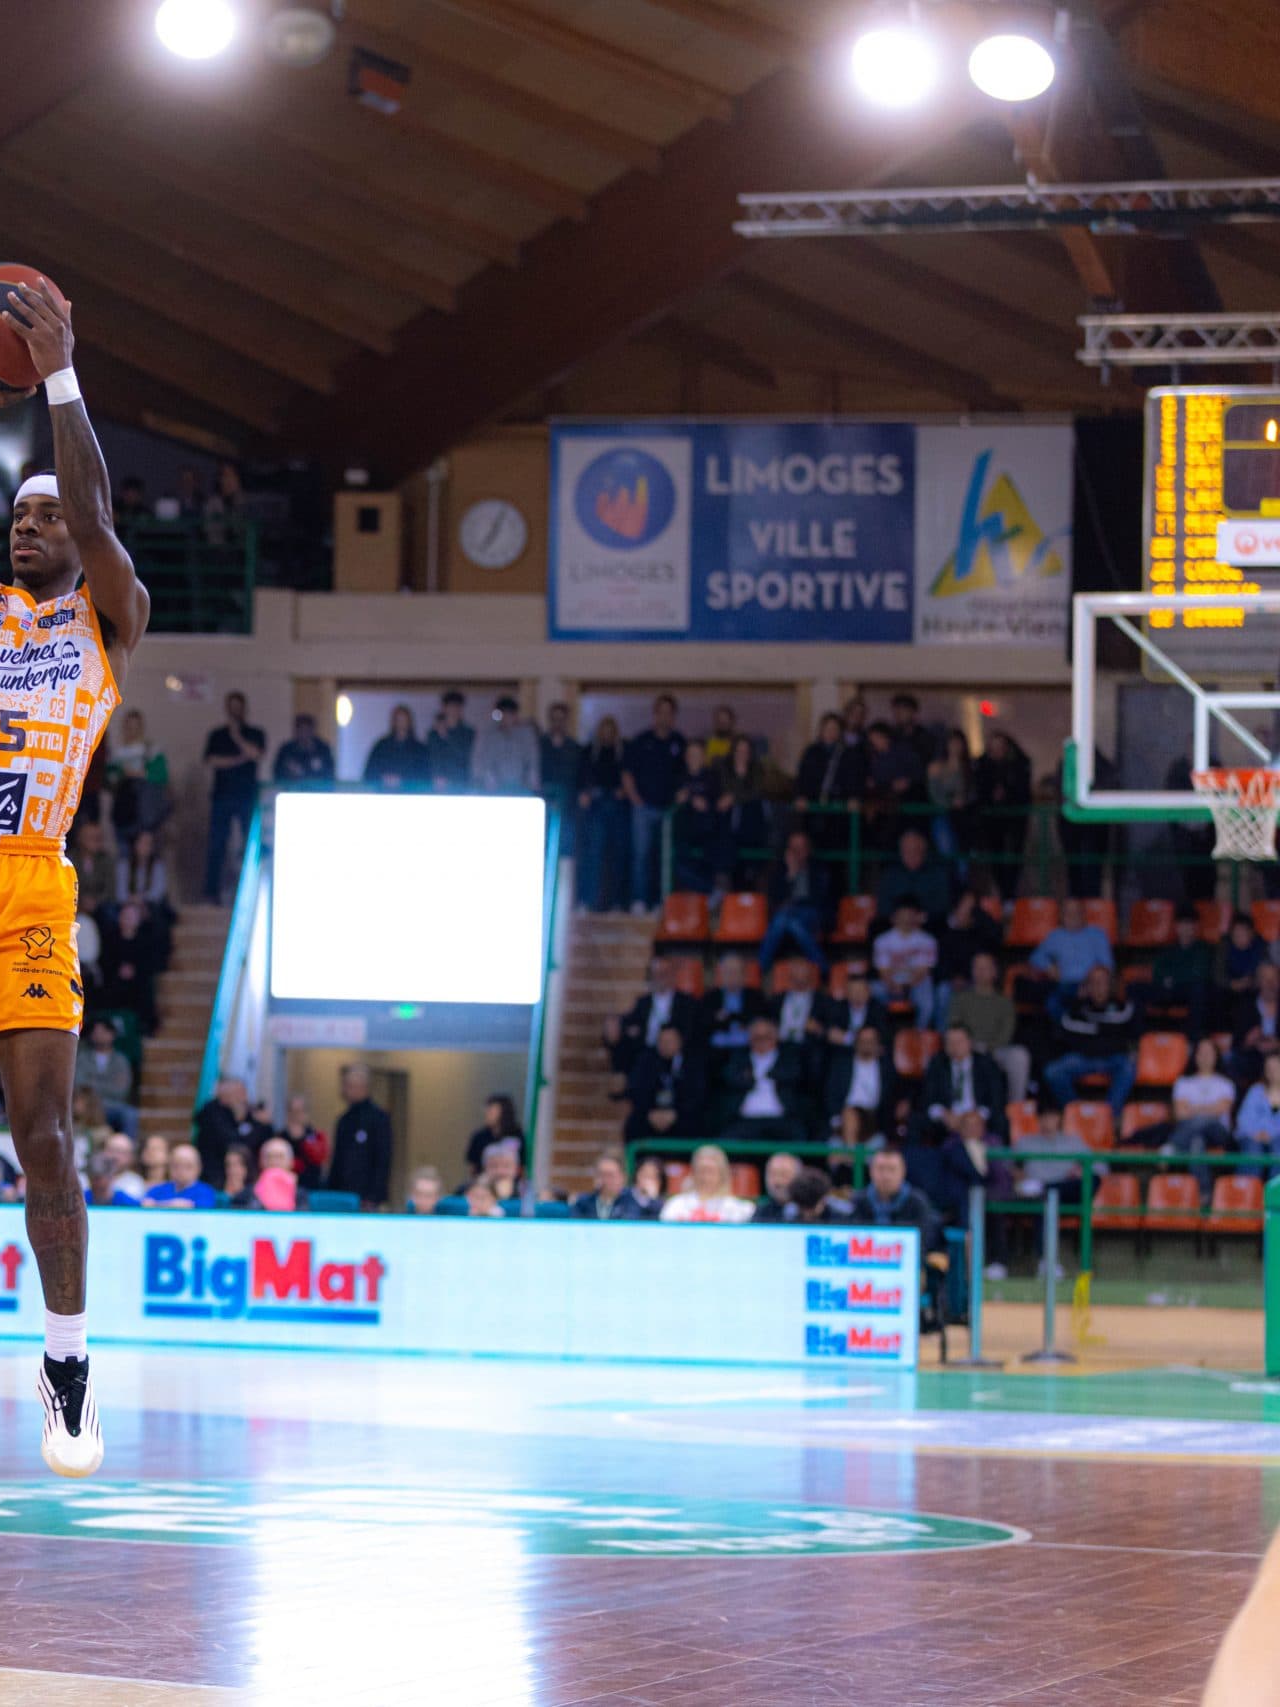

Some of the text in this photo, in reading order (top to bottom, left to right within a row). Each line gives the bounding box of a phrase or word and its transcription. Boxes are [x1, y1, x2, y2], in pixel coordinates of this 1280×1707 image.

[705, 454, 903, 495] LIMOGES
[748, 520, 857, 558] VILLE
[705, 571, 908, 611] SPORTIVE
[807, 1235, 902, 1265] BigMat
[144, 1235, 386, 1319] BigMat
[807, 1281, 902, 1311] BigMat
[806, 1326, 902, 1356] BigMat
